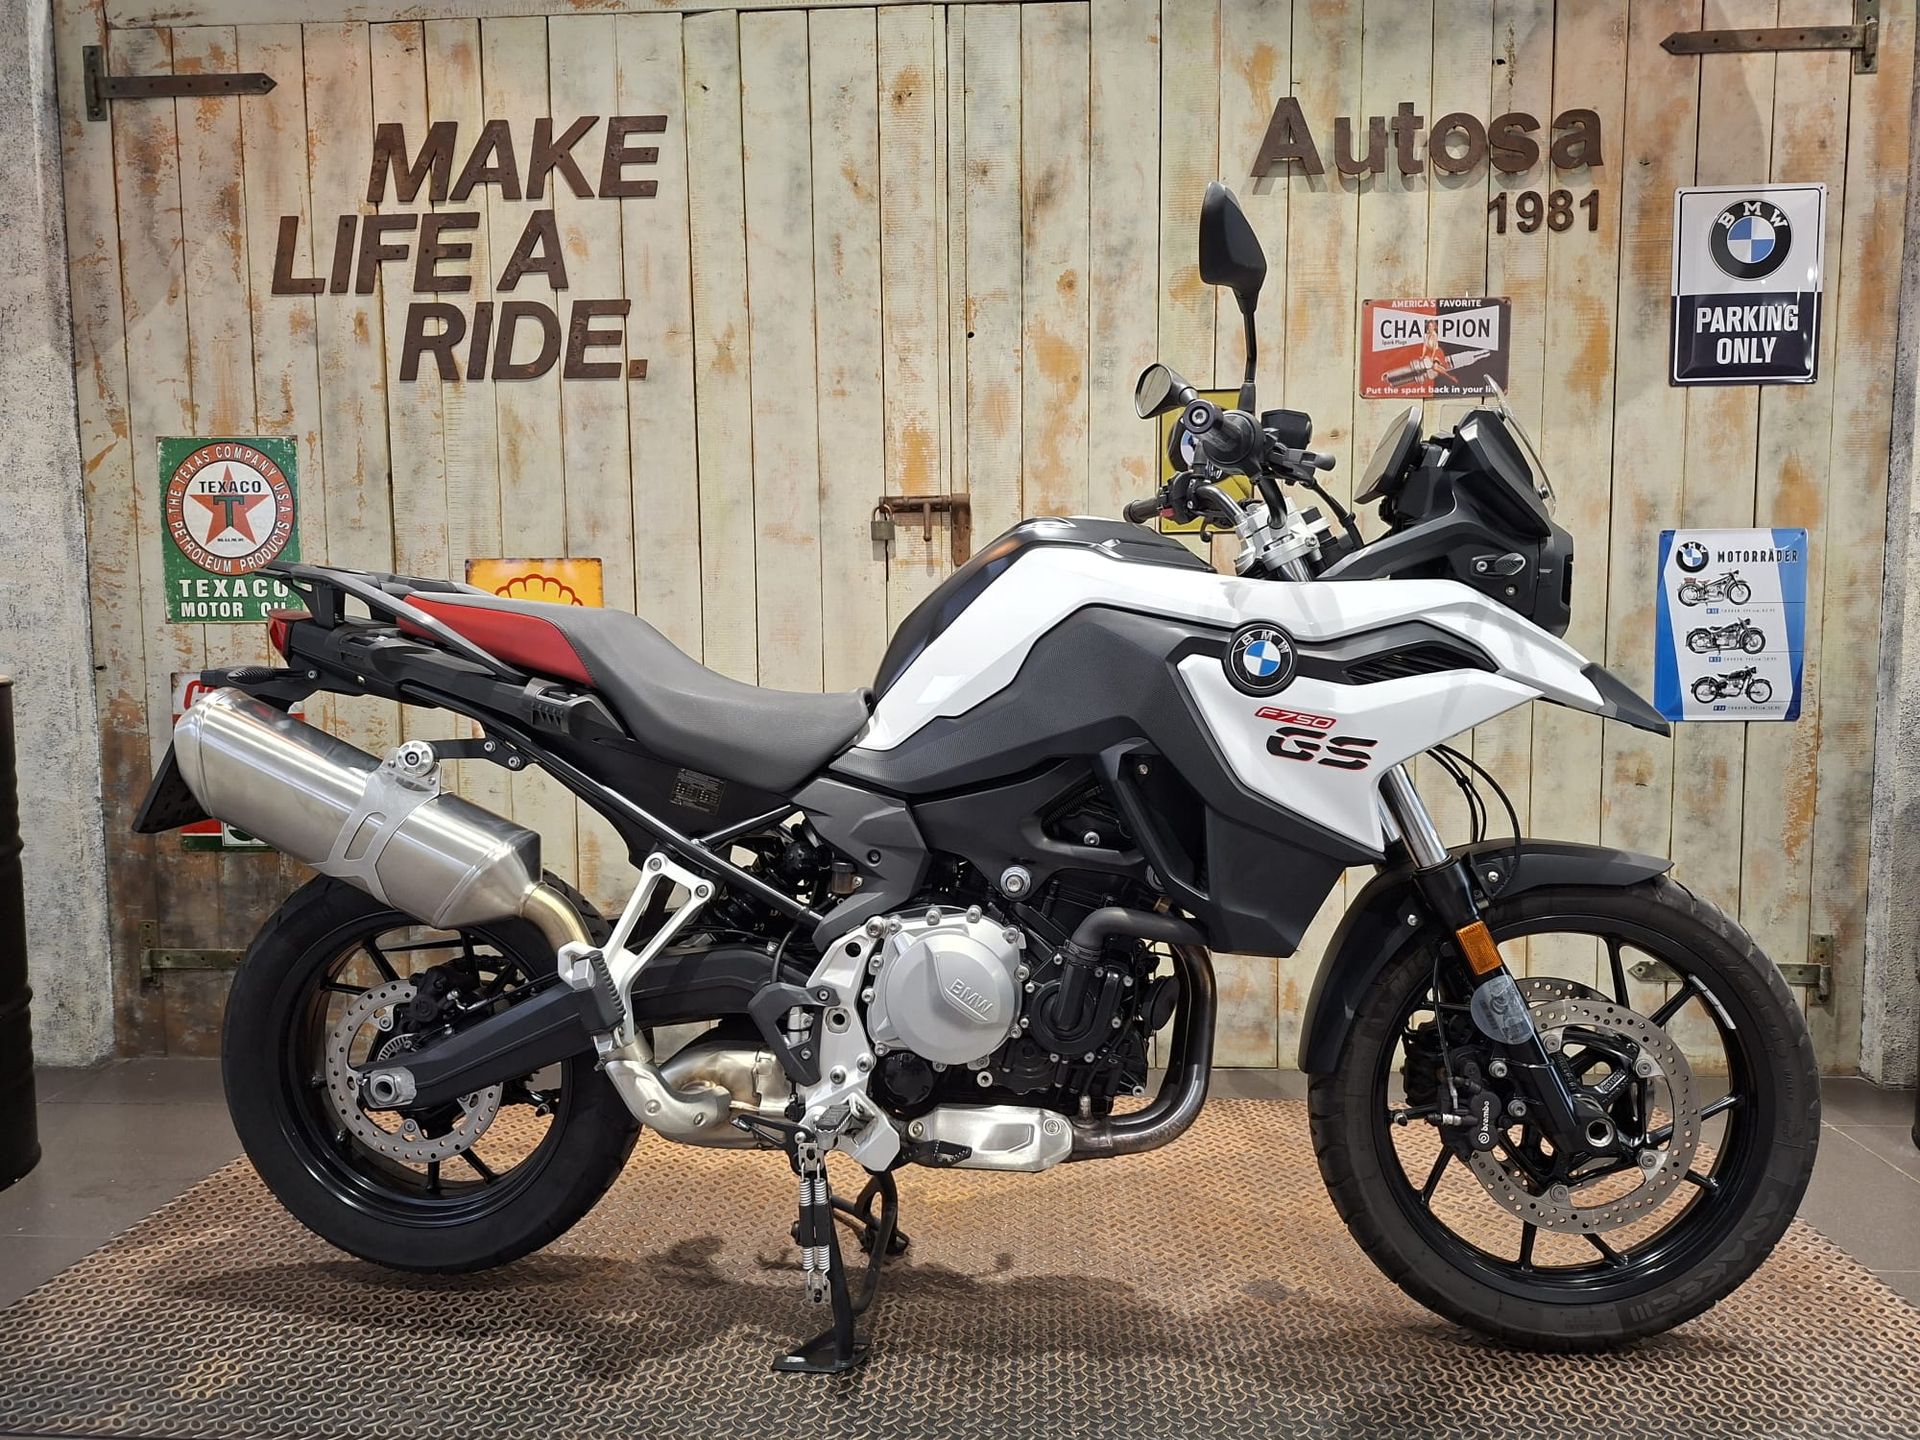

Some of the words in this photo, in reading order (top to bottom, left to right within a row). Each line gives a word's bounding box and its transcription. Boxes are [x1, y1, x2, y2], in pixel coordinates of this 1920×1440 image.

[1250, 97, 1604, 177] Autosa
[366, 115, 668, 203] MAKE
[1488, 189, 1600, 234] 1981
[1718, 201, 1788, 229] BMW
[271, 212, 480, 295] LIFE
[496, 209, 569, 291] A
[1392, 300, 1436, 308] AMERICA'S
[1439, 299, 1482, 307] FAVORITE
[1696, 304, 1800, 333] PARKING
[400, 299, 648, 381] RIDE.
[1716, 336, 1777, 365] ONLY
[1384, 386, 1399, 394] the
[1401, 386, 1426, 395] spark
[1428, 385, 1450, 393] back
[1451, 385, 1460, 393] in
[1462, 386, 1484, 395] your
[175, 450, 210, 485] TEXAS
[215, 446, 277, 477] COMPANY
[169, 489, 182, 514] THE
[199, 481, 261, 493] TEXACO
[171, 521, 232, 573] PETROLEUM
[240, 521, 290, 571] PRODUCTS
[179, 579, 289, 598] TEXACO
[181, 602, 244, 617] MOTOR
[1241, 630, 1289, 653] BMW
[1256, 707, 1334, 729] F750
[1266, 726, 1378, 771] GS
[950, 978, 993, 1013] BMW
[1481, 1101, 1490, 1132] brembo
